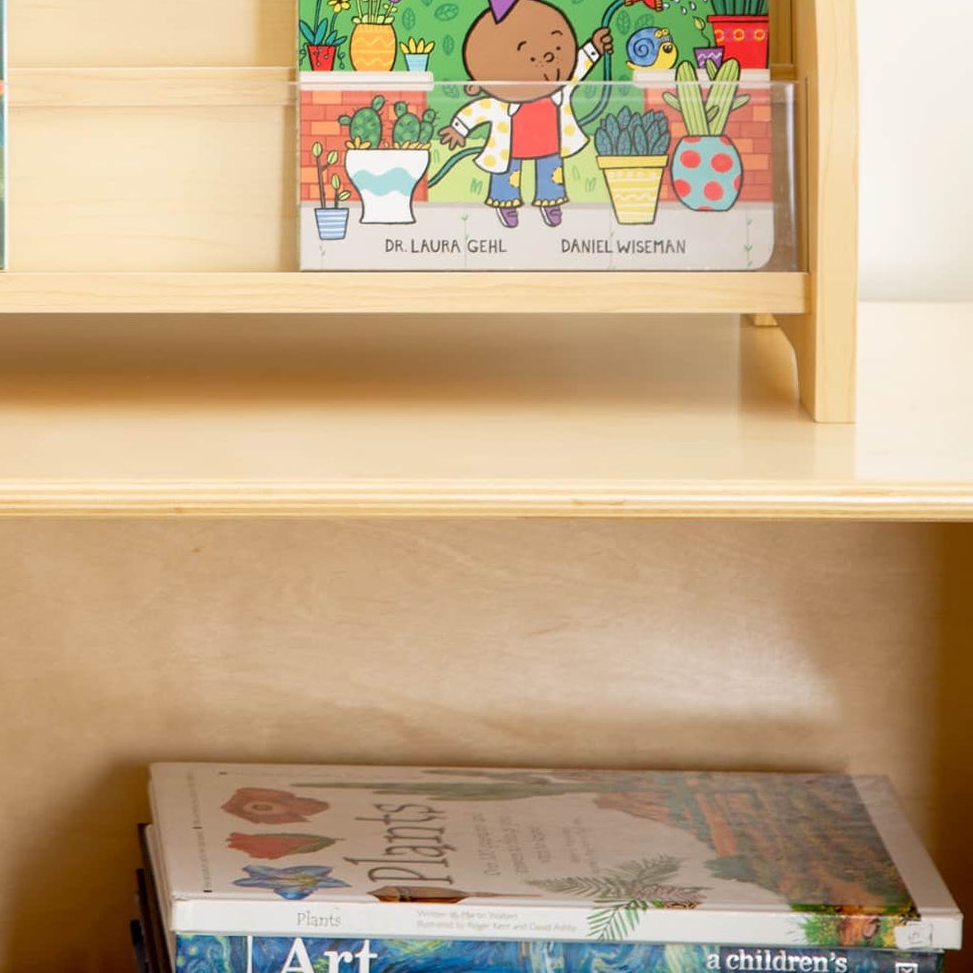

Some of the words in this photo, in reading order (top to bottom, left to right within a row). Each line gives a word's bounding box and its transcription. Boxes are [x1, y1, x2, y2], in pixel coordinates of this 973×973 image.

[384, 239, 408, 253] DR.
[410, 239, 461, 253] LAURA
[467, 239, 508, 253] GEHL
[561, 239, 613, 253] DANIEL
[617, 239, 687, 254] WISEMAN
[342, 802, 457, 885] Plants
[296, 910, 343, 929] Plants
[280, 936, 378, 973] Art
[706, 953, 721, 970] a
[727, 949, 849, 973] children's
